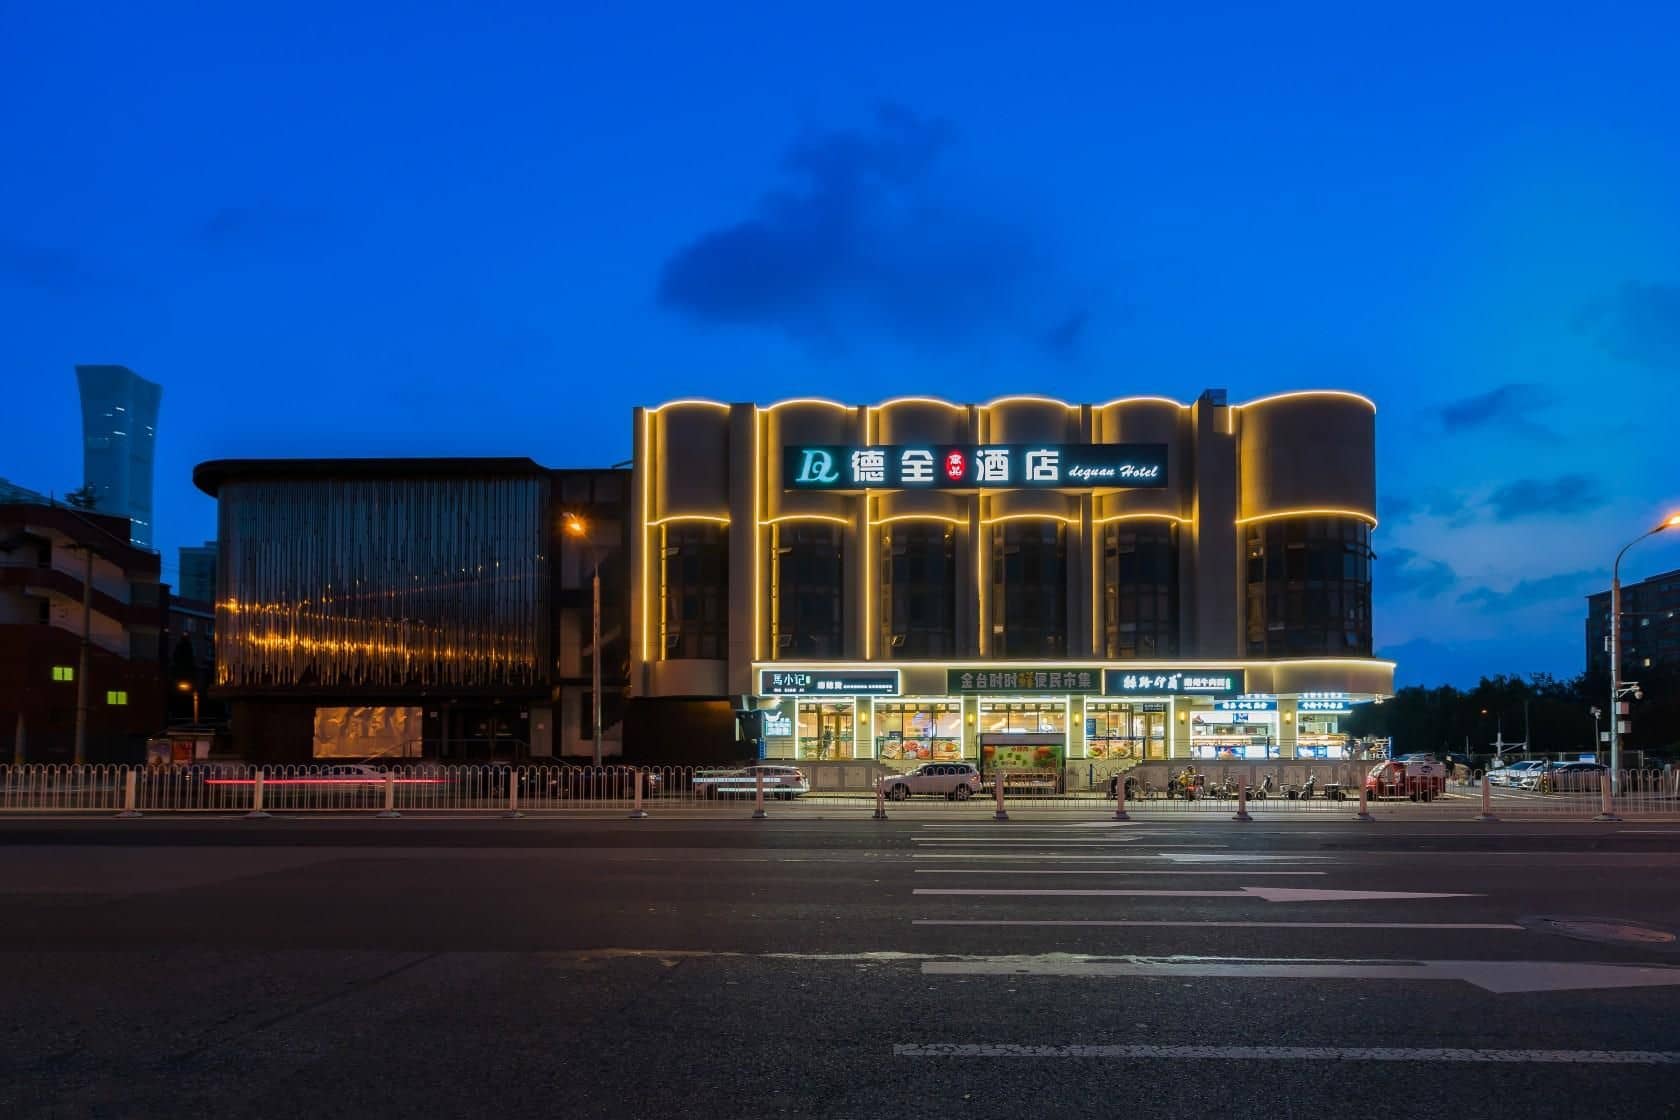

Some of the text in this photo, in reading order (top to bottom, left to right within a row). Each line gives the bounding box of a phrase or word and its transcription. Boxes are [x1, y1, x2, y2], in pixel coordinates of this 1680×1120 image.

[851, 450, 934, 482] 德全
[976, 450, 1059, 482] 酒店
[1119, 464, 1159, 478] Hotel
